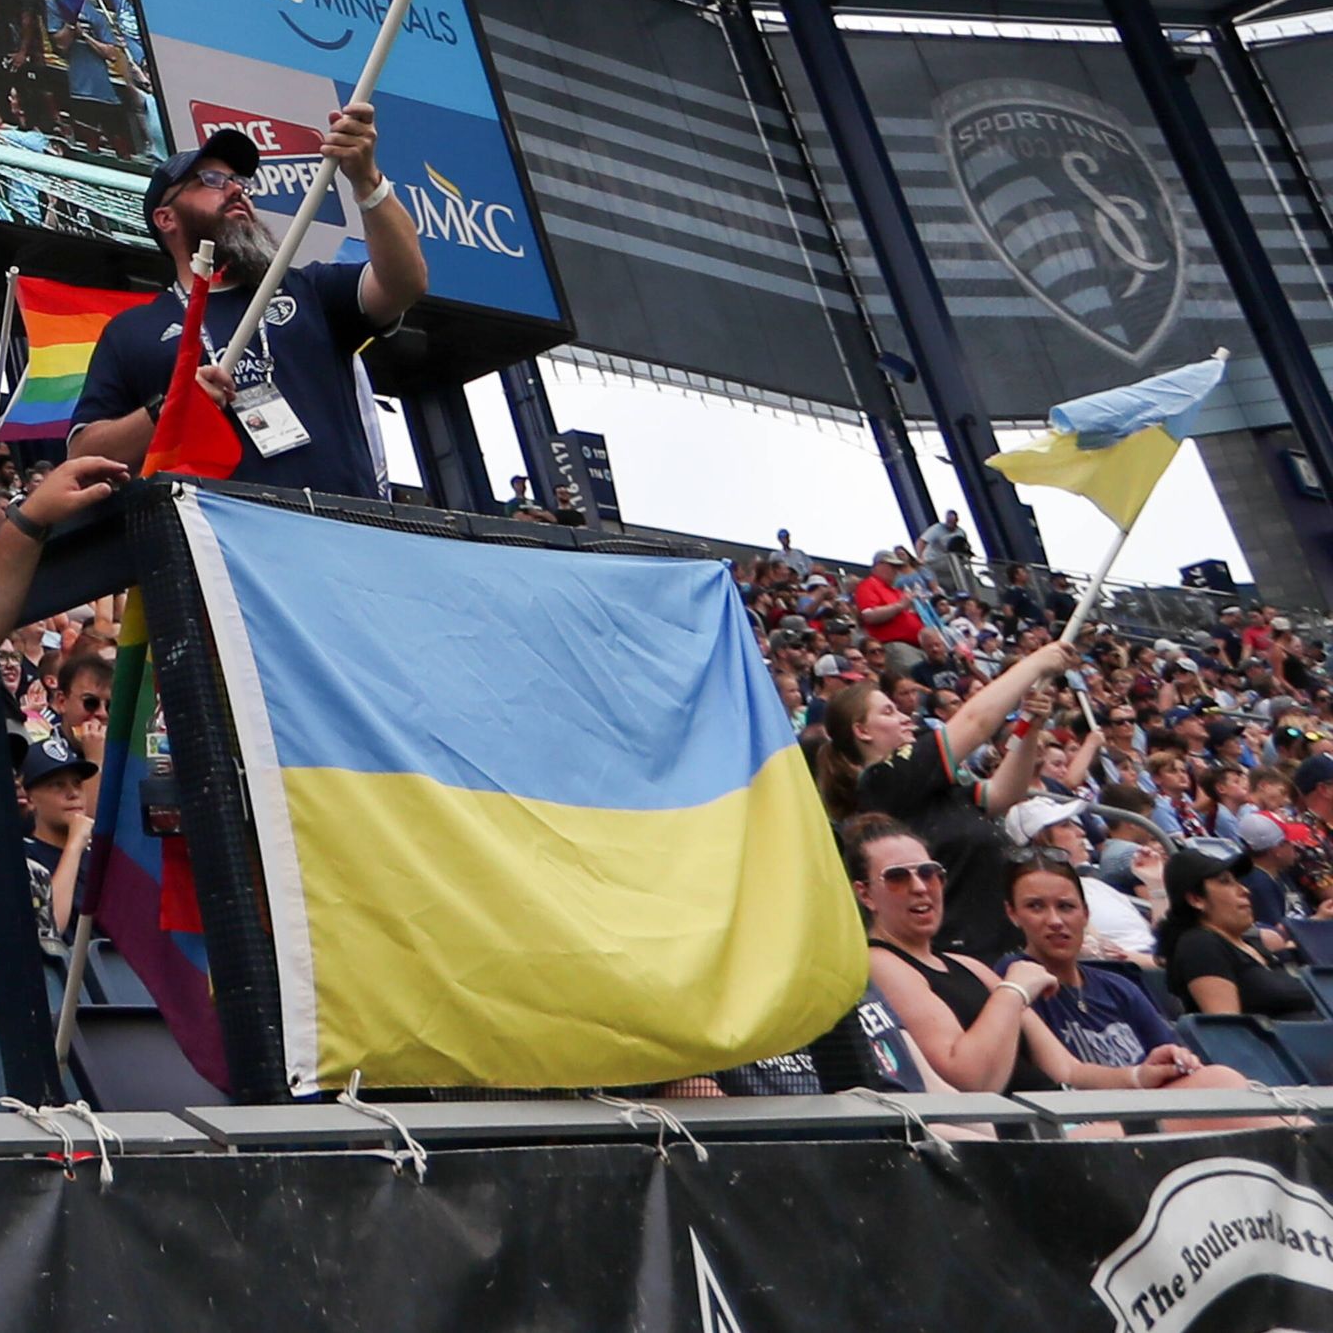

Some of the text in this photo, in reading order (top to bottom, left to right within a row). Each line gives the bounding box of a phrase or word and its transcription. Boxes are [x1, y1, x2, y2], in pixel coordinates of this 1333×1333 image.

[957, 111, 1131, 156] SPORTING
[1131, 1273, 1187, 1330] The
[1180, 1209, 1274, 1284] Boulevard
